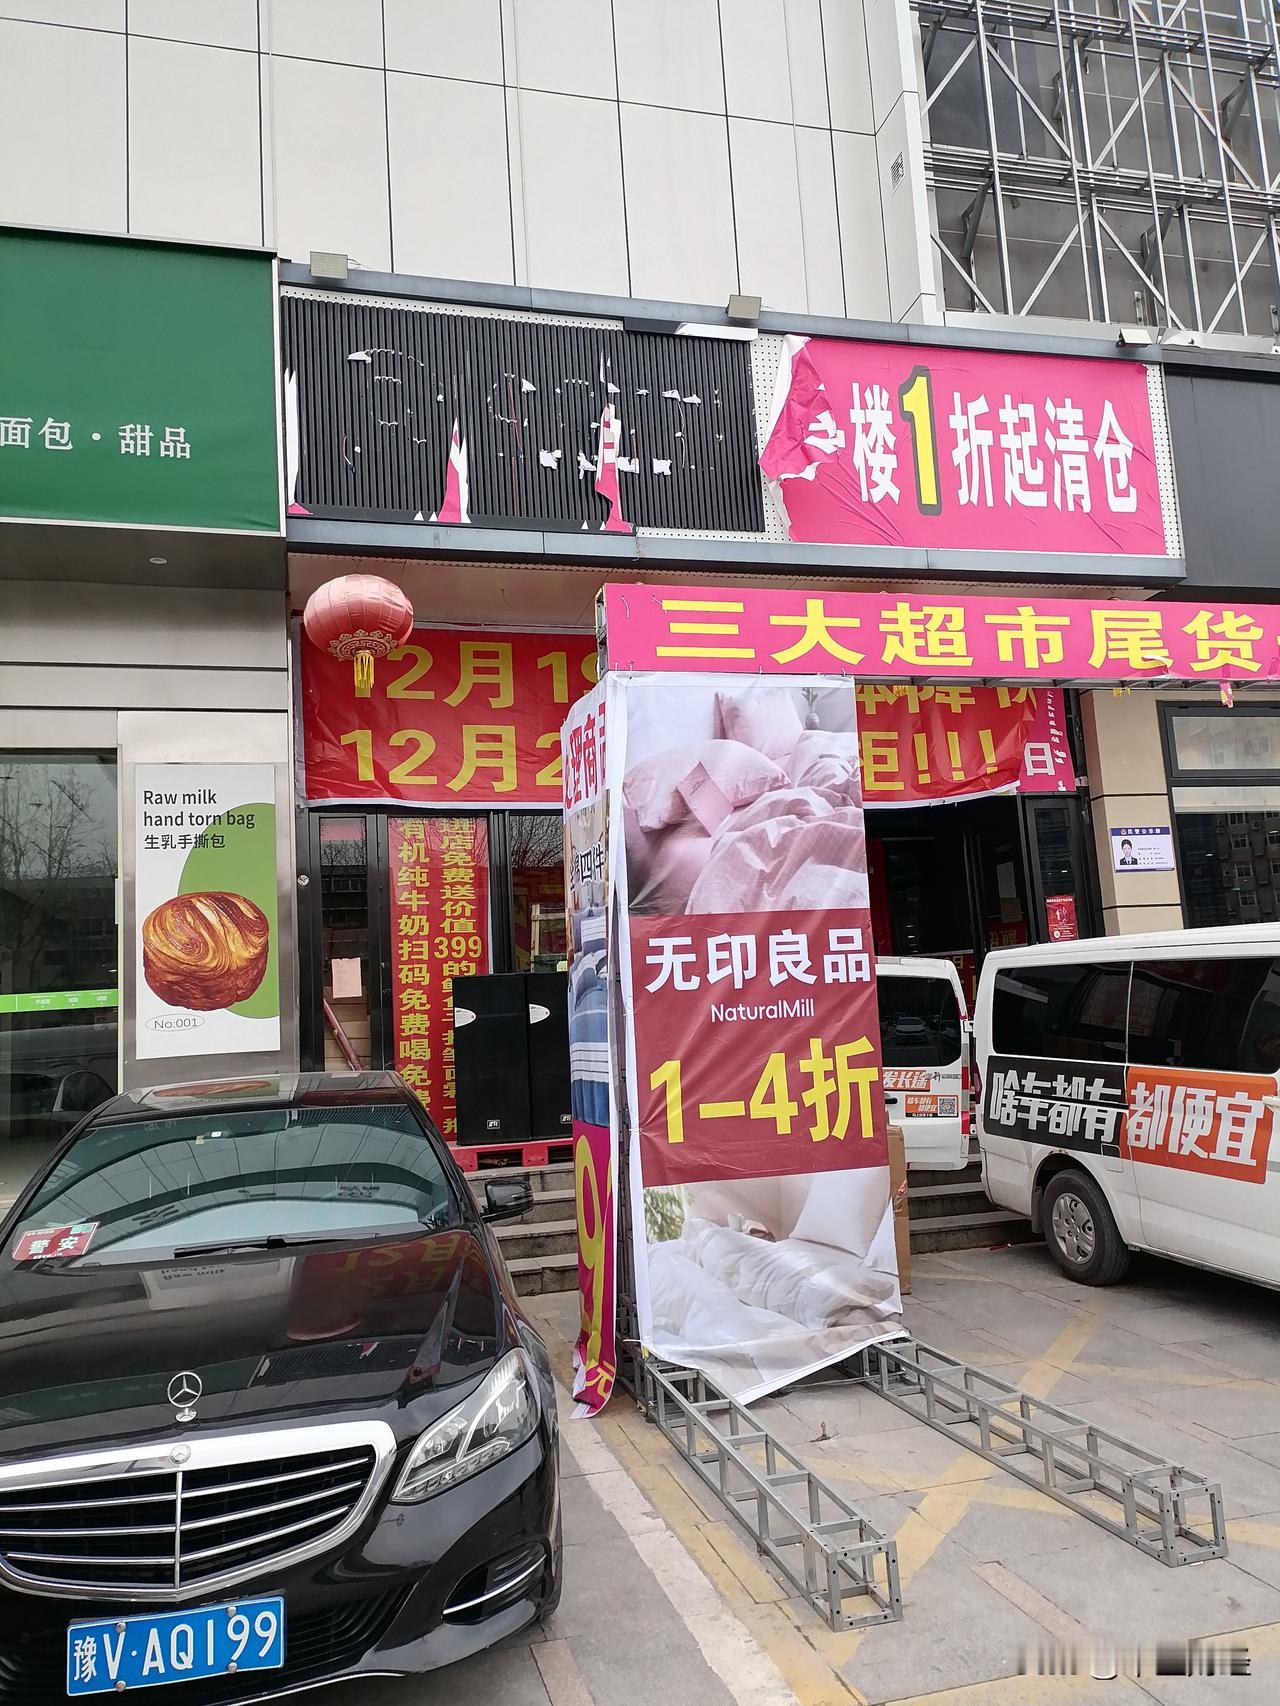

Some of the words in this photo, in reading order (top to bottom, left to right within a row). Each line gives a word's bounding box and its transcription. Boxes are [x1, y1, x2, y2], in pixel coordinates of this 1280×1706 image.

[656, 598, 1280, 673] 三大超市尾货
[354, 641, 598, 709] 2月1
[143, 789, 178, 805] Raw
[182, 788, 217, 804] milk
[143, 812, 184, 827] hand
[189, 812, 222, 826] torn
[226, 810, 255, 829] bag
[144, 833, 226, 851] 生乳手撕包
[644, 928, 871, 993] 无印良品
[153, 1016, 198, 1030] No:001
[710, 998, 815, 1023] NaturalMill
[989, 1069, 1122, 1143] 啥车都有
[1127, 1081, 1267, 1166] 都便宜
[73, 1610, 278, 1684] 豫V·AQ199
